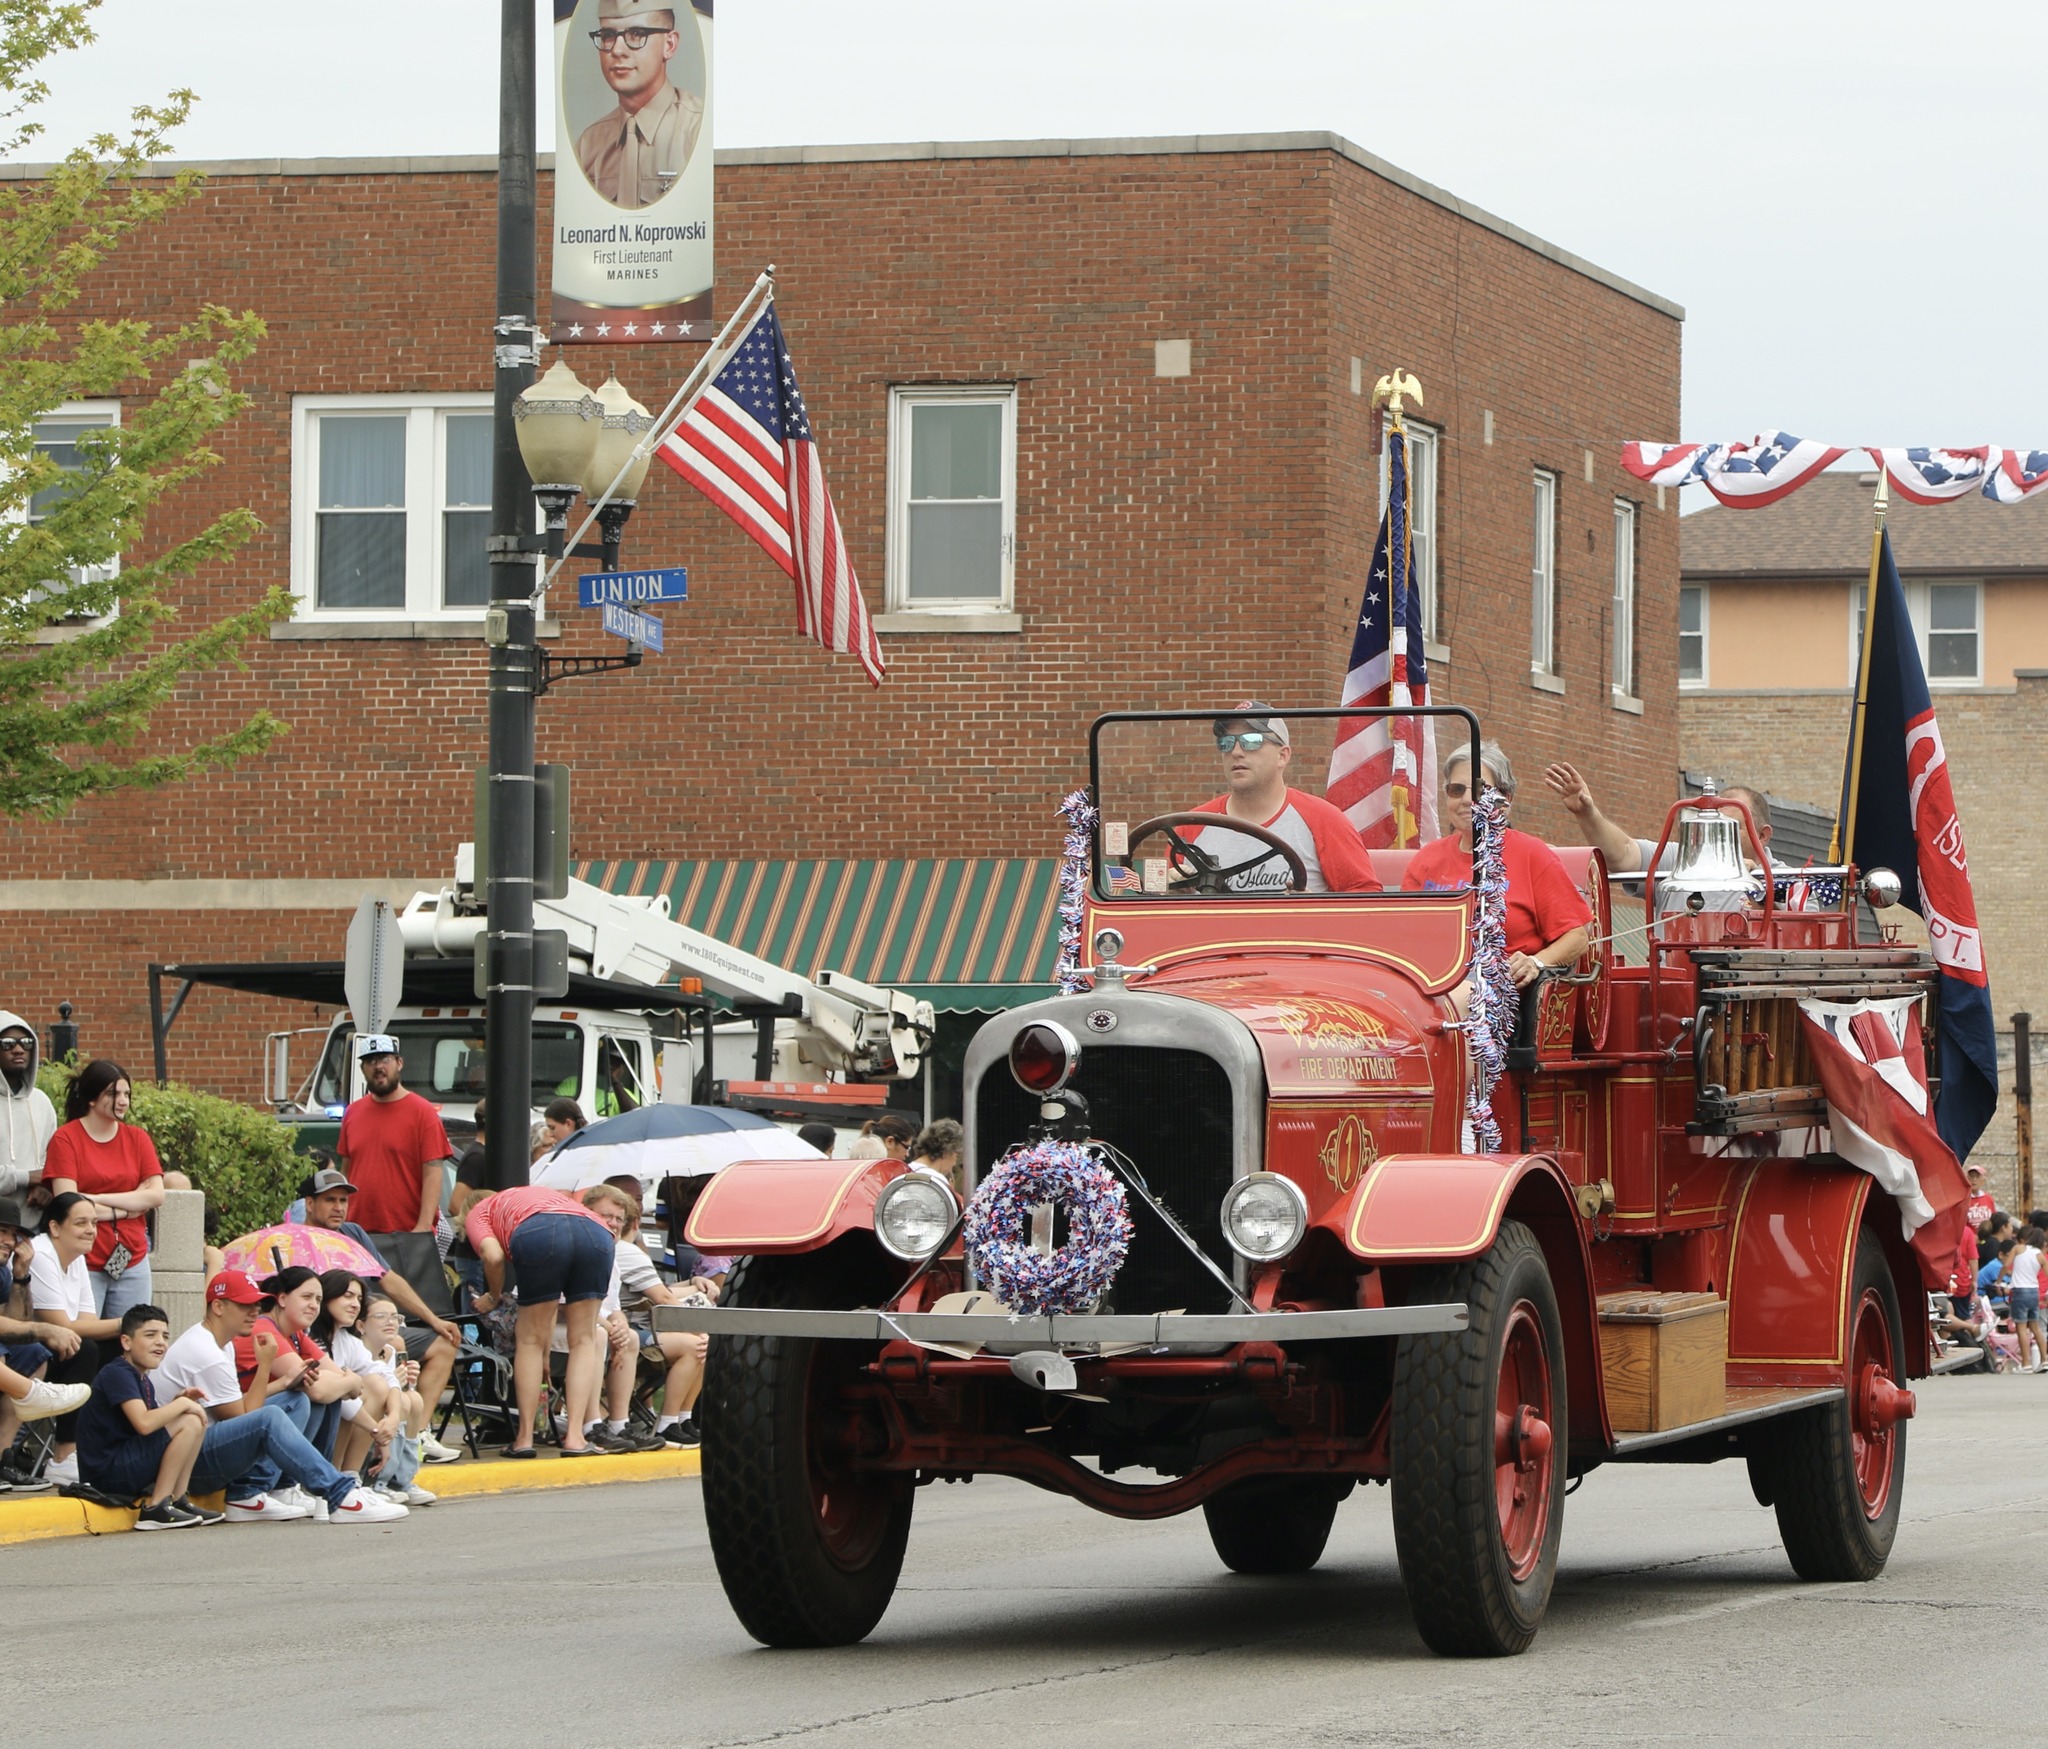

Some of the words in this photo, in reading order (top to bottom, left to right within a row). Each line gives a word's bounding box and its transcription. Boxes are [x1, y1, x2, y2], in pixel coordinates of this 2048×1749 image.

[560, 224, 616, 244] Leonard
[619, 224, 632, 242] N.
[635, 221, 706, 245] Koprowski
[593, 249, 617, 265] First
[618, 248, 673, 264] Lieutenant
[607, 268, 659, 280] MARINES
[591, 575, 663, 604] UNION
[605, 602, 646, 642] WESTERN
[1236, 863, 1292, 889] Island
[1299, 1057, 1326, 1080] FIRE
[1326, 1056, 1398, 1080] DEPARTMENT
[214, 1283, 227, 1293] CHI
